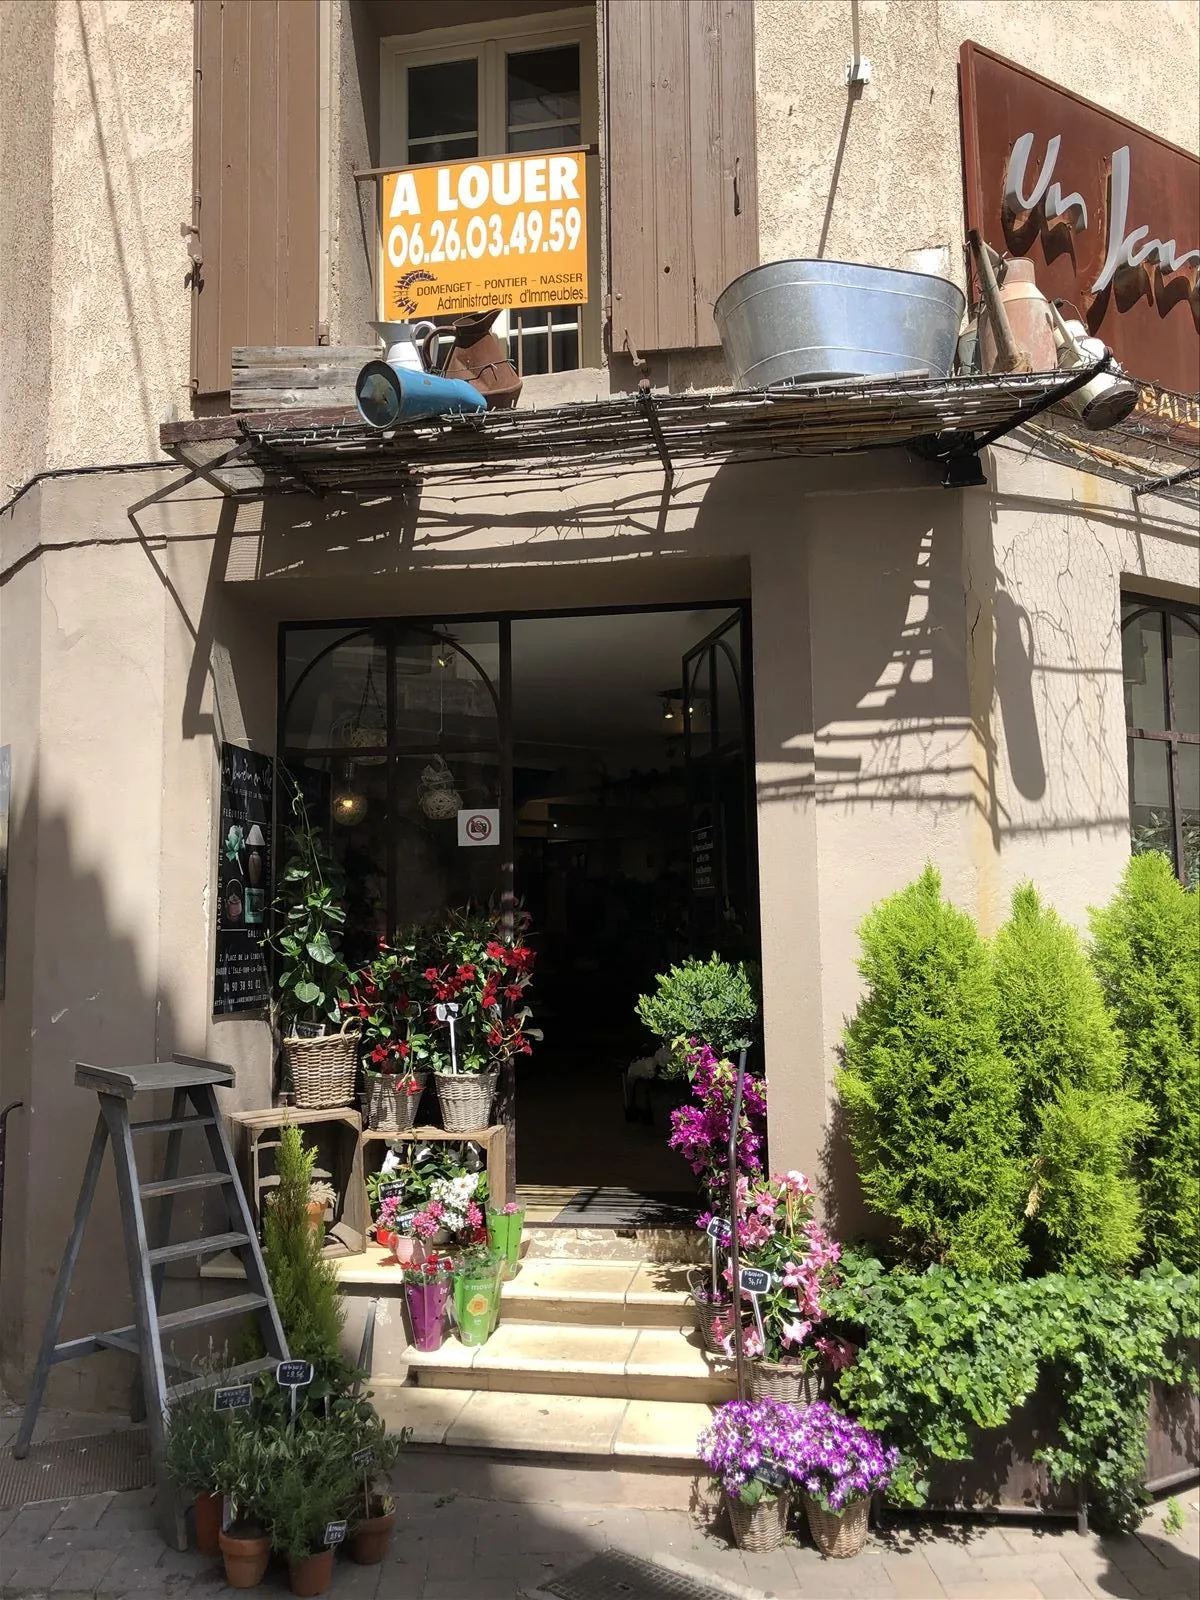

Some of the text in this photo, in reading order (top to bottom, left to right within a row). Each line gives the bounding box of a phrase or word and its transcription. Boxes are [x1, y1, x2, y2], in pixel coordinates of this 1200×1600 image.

[389, 156, 580, 218] A LOUER
[1002, 132, 1088, 230] Un
[387, 206, 582, 268] 06.26.03.49.59
[416, 281, 473, 297] DOMENGET
[484, 276, 528, 290] PONTIER
[539, 272, 584, 285] NASSER
[437, 292, 513, 311] Administrateurs
